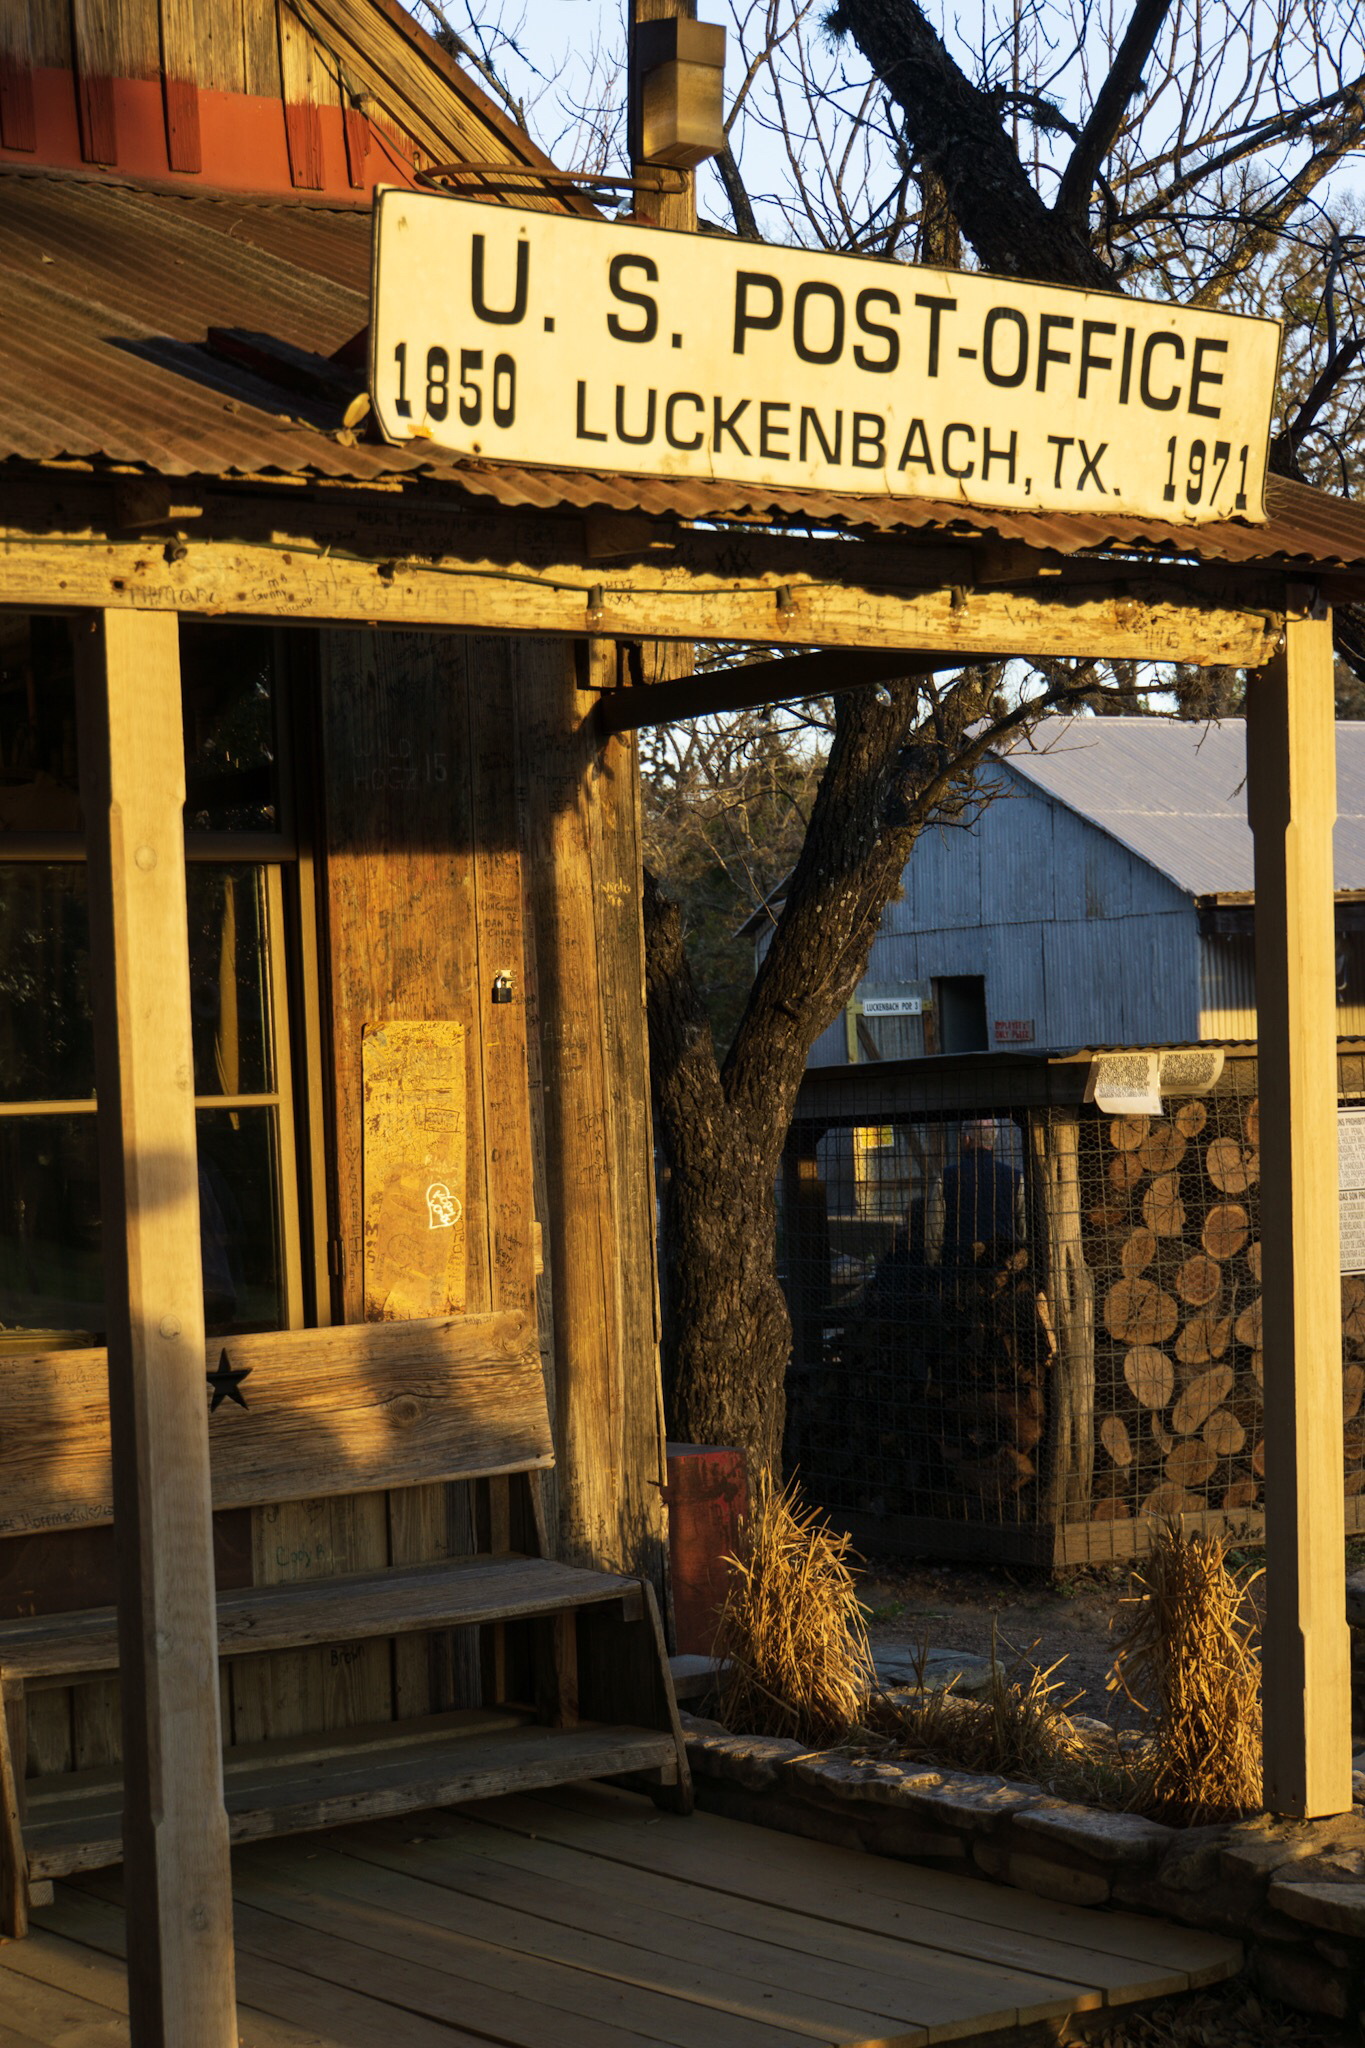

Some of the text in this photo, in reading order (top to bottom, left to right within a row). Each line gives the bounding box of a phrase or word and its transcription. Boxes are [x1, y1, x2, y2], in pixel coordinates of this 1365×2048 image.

[471, 233, 1229, 420] U. S. POST-OFFICE
[395, 342, 517, 429] 1850
[1047, 434, 1121, 497] TX.
[1163, 435, 1250, 511] 1971
[866, 1002, 899, 1012] LUCKENBACH
